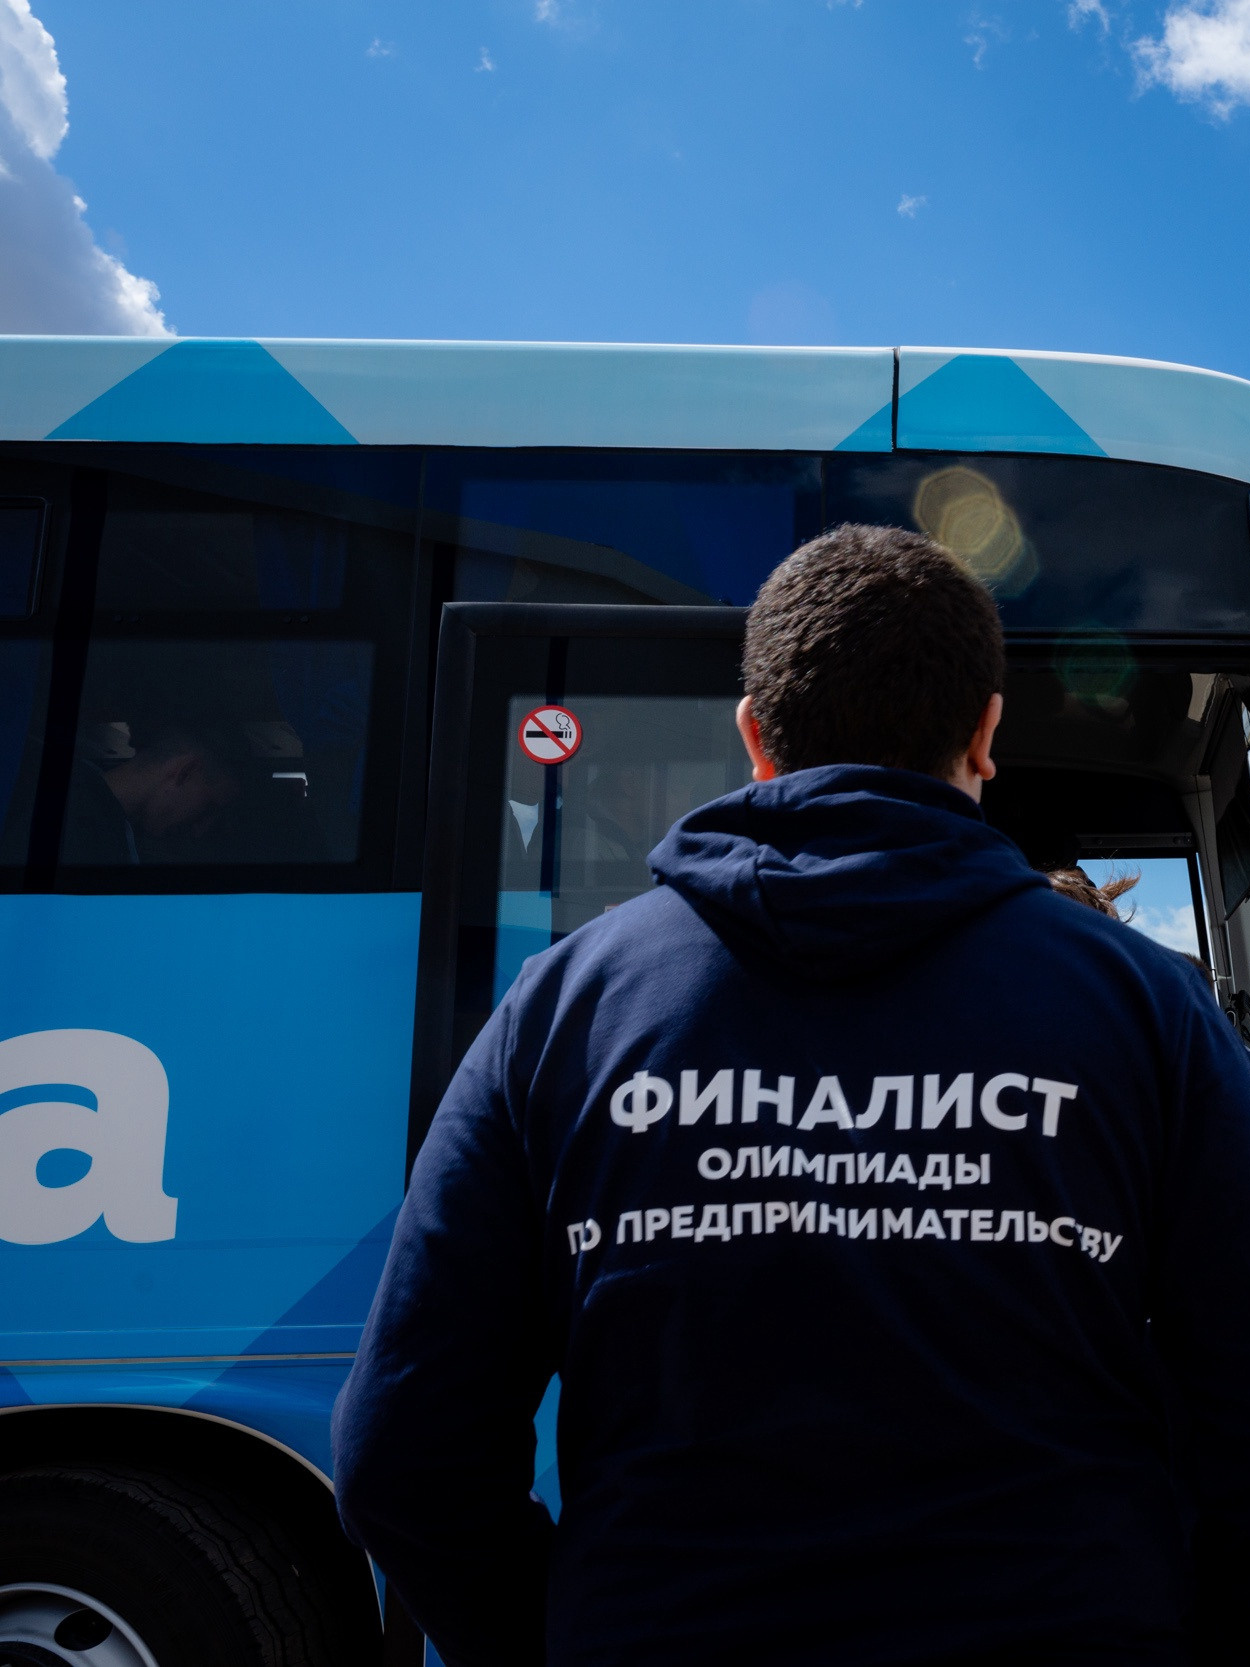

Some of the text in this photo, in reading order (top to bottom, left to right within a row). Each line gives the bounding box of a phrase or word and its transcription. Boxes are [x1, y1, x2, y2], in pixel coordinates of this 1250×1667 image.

[609, 1068, 1079, 1137] ФИНАЛИСТ
[697, 1145, 991, 1191] ОЛИМПИАДЫ
[616, 1201, 1123, 1263] ПРЕДПРИНИМАТЕЛЬСВУ
